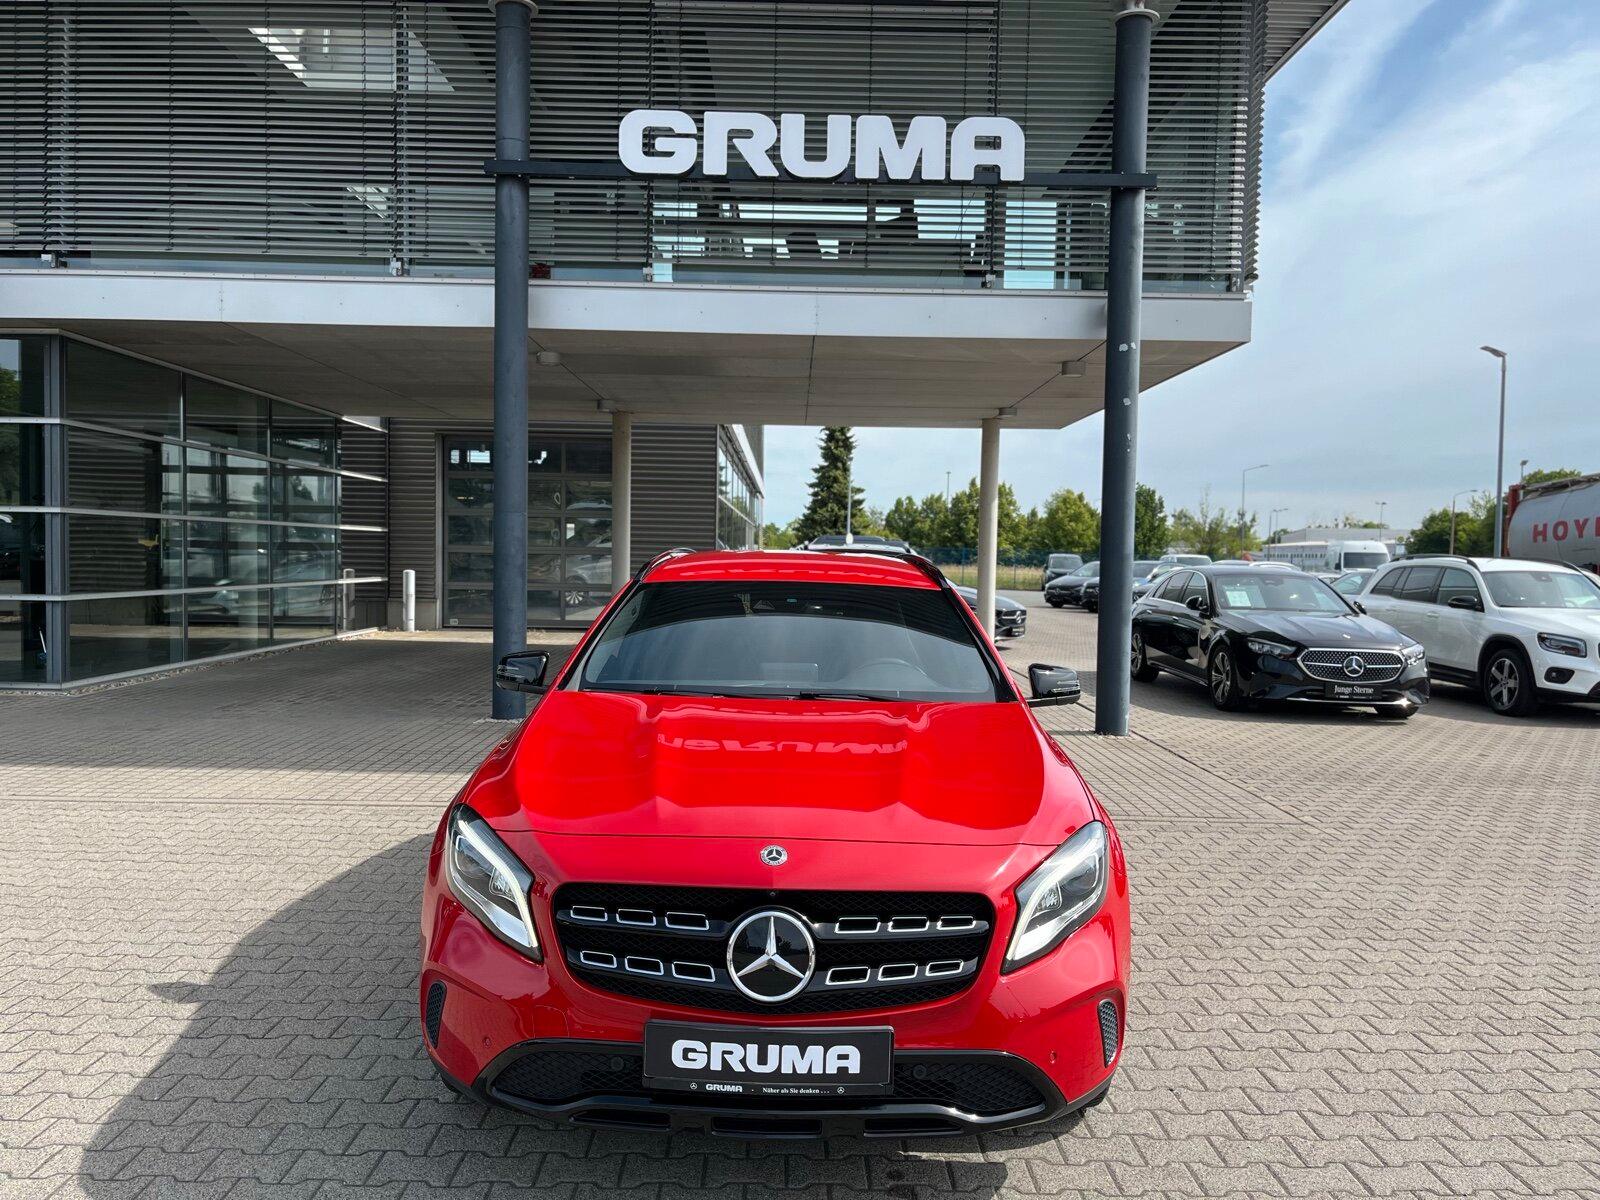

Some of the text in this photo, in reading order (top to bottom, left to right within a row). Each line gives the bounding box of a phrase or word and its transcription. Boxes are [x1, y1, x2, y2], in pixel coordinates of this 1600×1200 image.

[618, 109, 1026, 182] GRUMA
[1334, 684, 1374, 694] Junge Sterne
[671, 1039, 861, 1074] GRUMA
[705, 1083, 743, 1093] GRUMA
[762, 1086, 780, 1094] Näher
